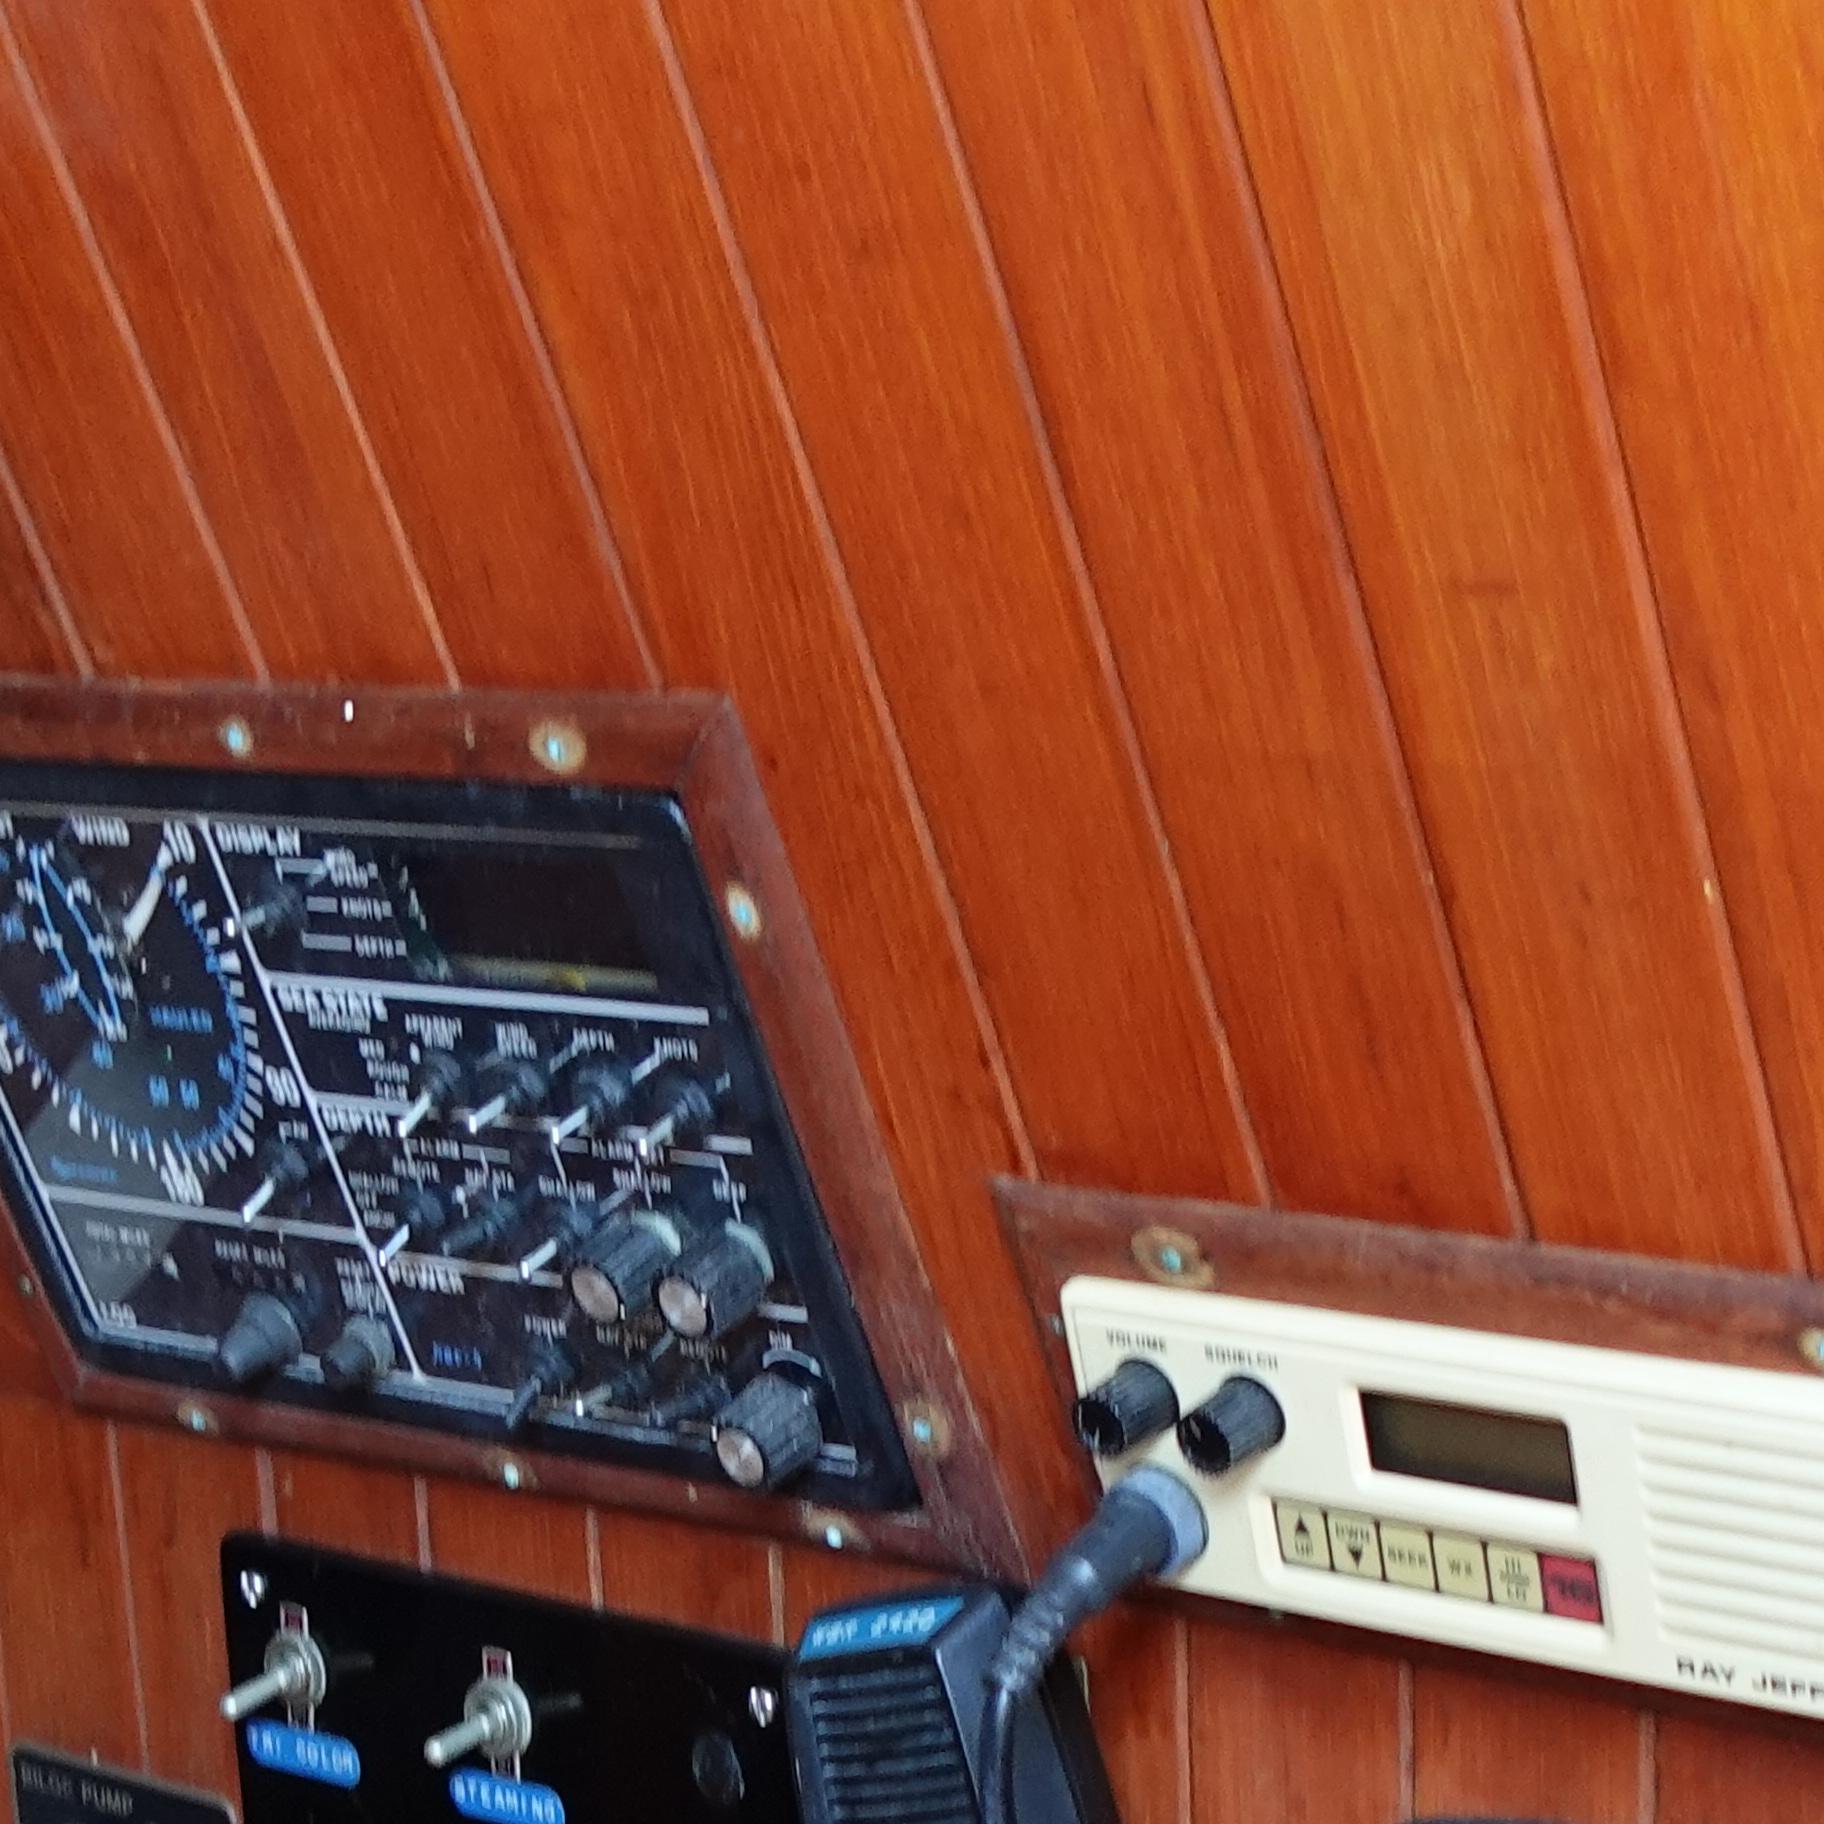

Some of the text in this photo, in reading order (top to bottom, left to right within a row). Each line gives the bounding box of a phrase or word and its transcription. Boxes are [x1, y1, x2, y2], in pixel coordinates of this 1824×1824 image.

[71, 814, 131, 847] WIND
[214, 821, 301, 857] DISPLAY
[321, 1104, 392, 1138] DEPTH
[388, 1260, 466, 1296] POWER
[1106, 1327, 1166, 1353] VOLUME
[1204, 1343, 1279, 1373] SQUELCH
[1676, 1654, 1736, 1689] RAY
[81, 1780, 135, 1818] PUMP
